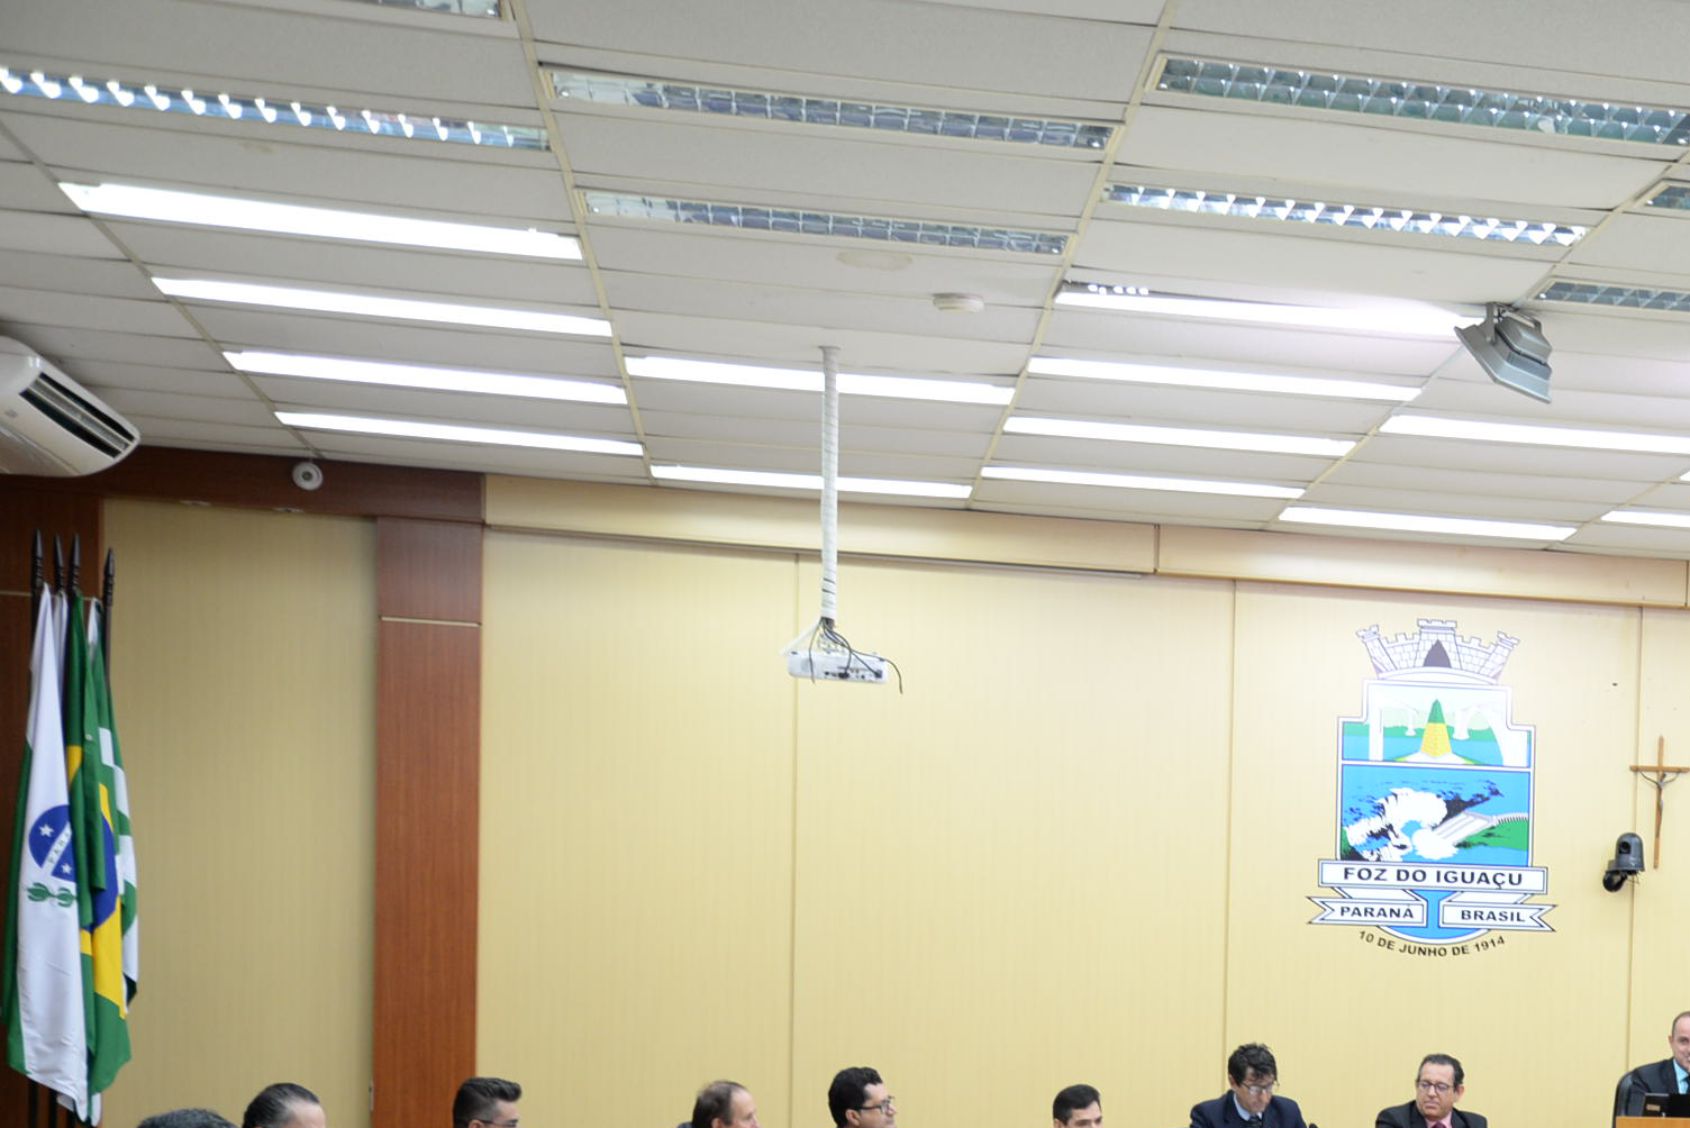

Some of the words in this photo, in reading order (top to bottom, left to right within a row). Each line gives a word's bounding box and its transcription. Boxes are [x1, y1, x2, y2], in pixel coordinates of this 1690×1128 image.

[1344, 867, 1387, 881] FOZ
[1396, 869, 1427, 882] DO
[1436, 870, 1522, 889] IGUAÇU
[1340, 904, 1414, 919] PARANÁ
[1461, 909, 1526, 922] BRASIL
[1360, 930, 1375, 943] 10
[1377, 937, 1396, 950] DE
[1399, 944, 1447, 957] JUNHO
[1452, 945, 1470, 956] DE
[1475, 935, 1505, 952] 1914
